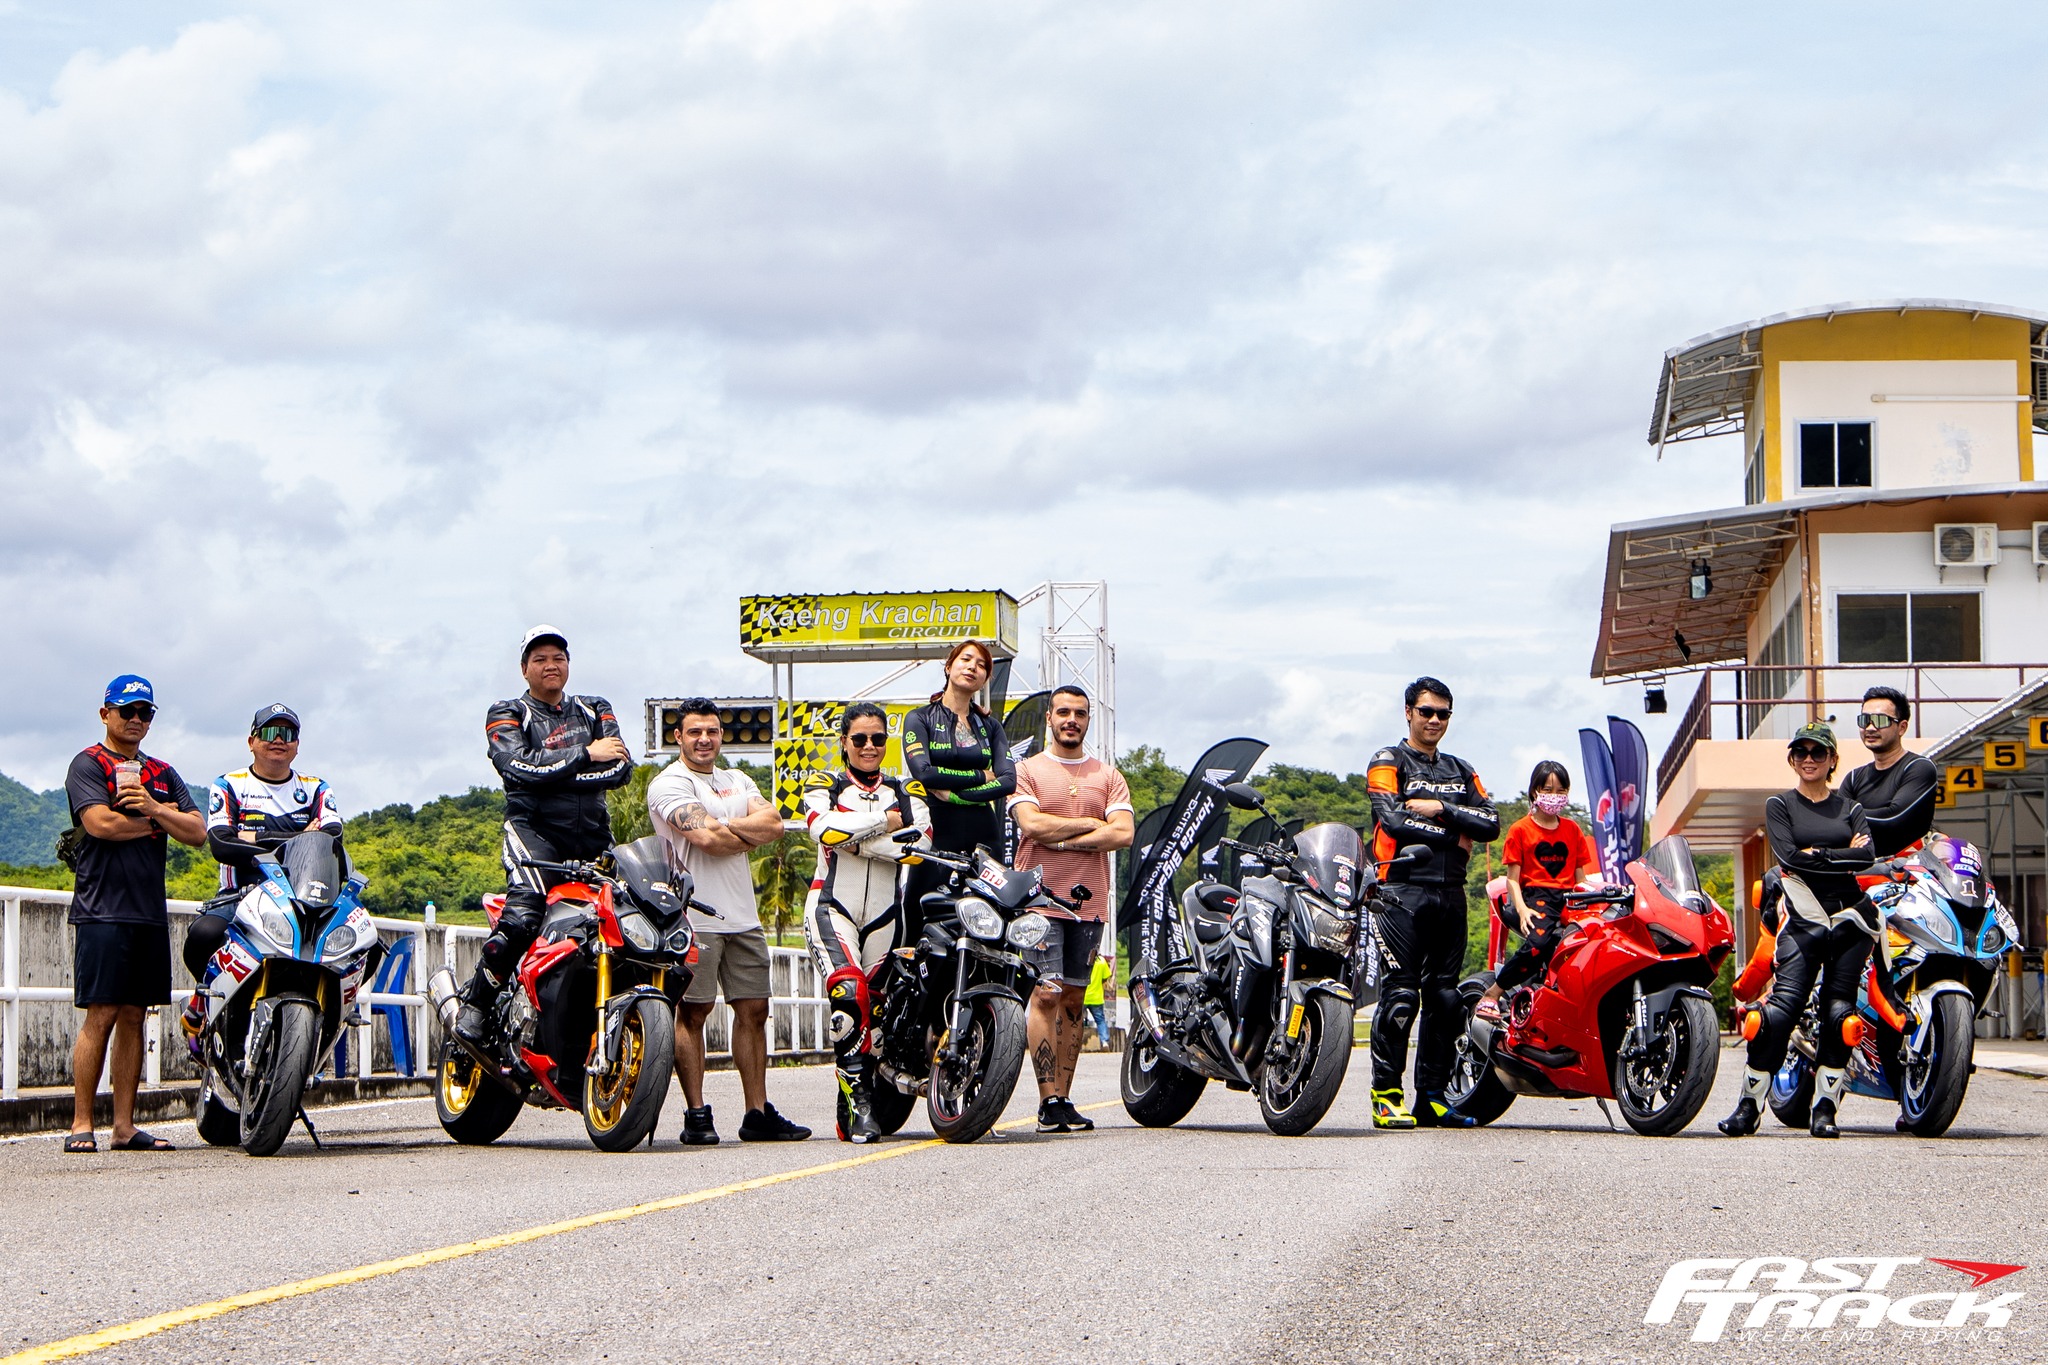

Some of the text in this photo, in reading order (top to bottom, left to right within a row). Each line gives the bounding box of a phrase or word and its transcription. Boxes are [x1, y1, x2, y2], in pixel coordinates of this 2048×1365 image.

[756, 599, 983, 632] Kaeng Krachan
[887, 625, 979, 639] CIRCUIT
[509, 758, 567, 774] KOMINE
[1994, 745, 2016, 767] 5
[1406, 780, 1467, 794] DAINESE
[1953, 768, 1977, 788] 4
[1180, 795, 1215, 851] Honda
[1404, 818, 1446, 835] DAINESE
[1004, 839, 1013, 864] THE
[1160, 840, 1177, 860] THE
[981, 869, 1004, 887] DID
[1140, 861, 1164, 898] WORLD
[1141, 917, 1150, 937] THE
